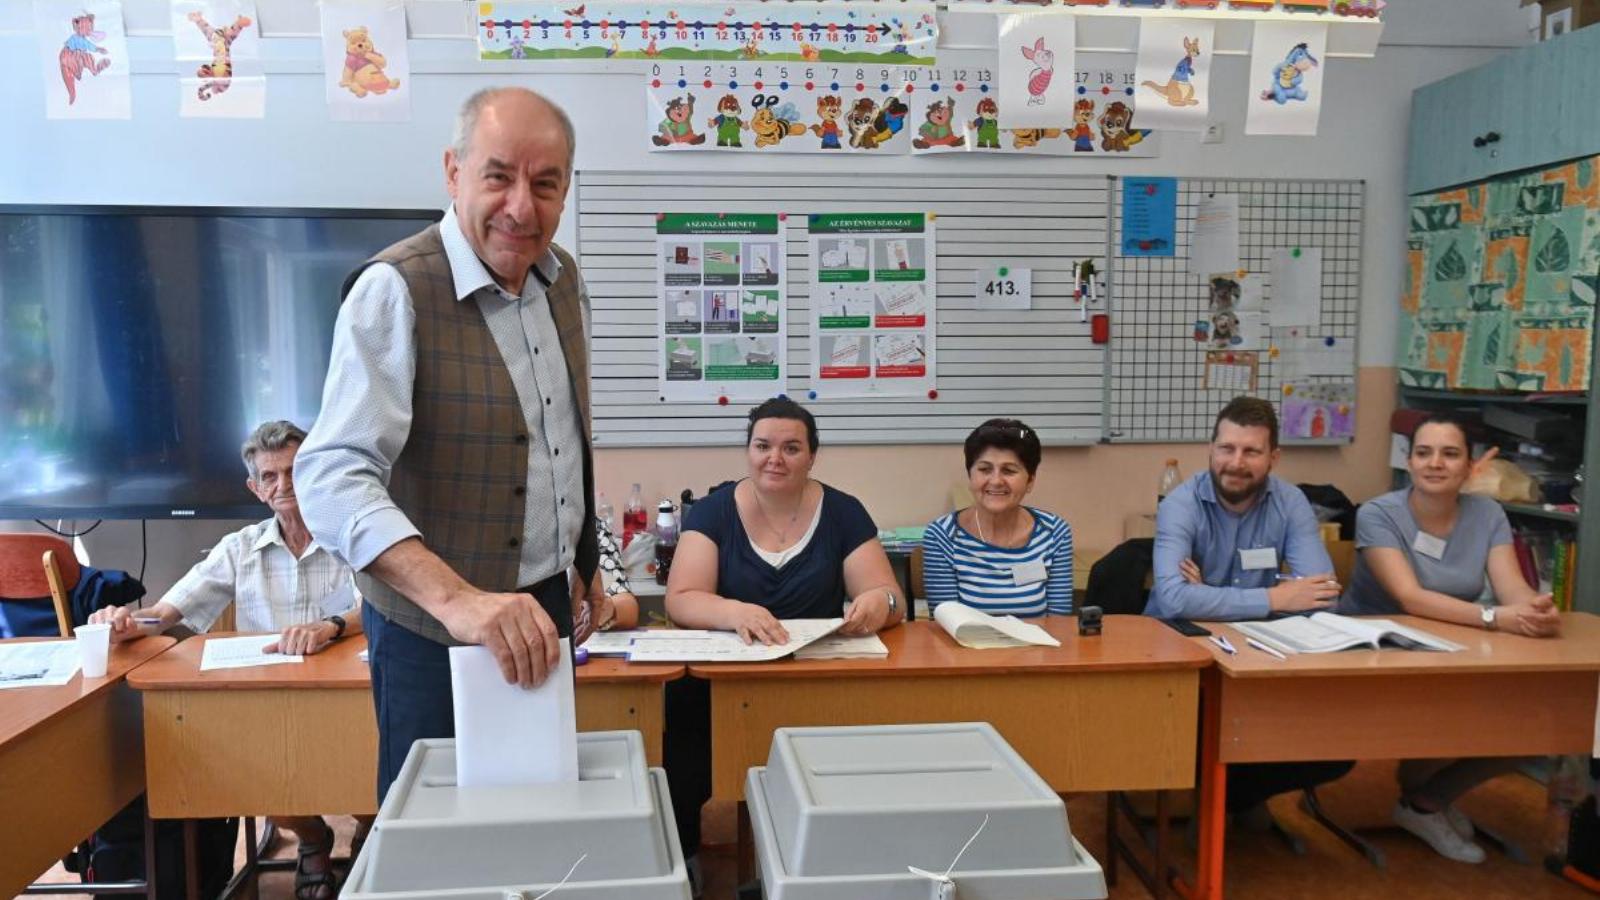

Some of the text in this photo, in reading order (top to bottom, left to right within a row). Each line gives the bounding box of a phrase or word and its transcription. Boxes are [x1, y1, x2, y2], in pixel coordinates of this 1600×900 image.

[487, 30, 878, 42] 0 1 2 3 4 5 6 7 8 9 10 11 12 13 14 15 16 17 18 19 20
[652, 64, 660, 76] 0
[680, 66, 685, 76] 1
[704, 66, 712, 77] 2
[730, 66, 736, 78] 3
[755, 66, 762, 78] 4
[780, 67, 788, 78] 5
[806, 68, 814, 78] 6
[831, 68, 838, 78] 7
[856, 69, 864, 79] 8
[880, 70, 888, 80] 9
[903, 70, 916, 81] 10
[928, 70, 941, 80] 11
[953, 70, 966, 80] 12
[978, 70, 992, 82] 13
[1074, 72, 1089, 83] 17
[1100, 72, 1113, 84] 18
[986, 280, 1020, 296] 413.
